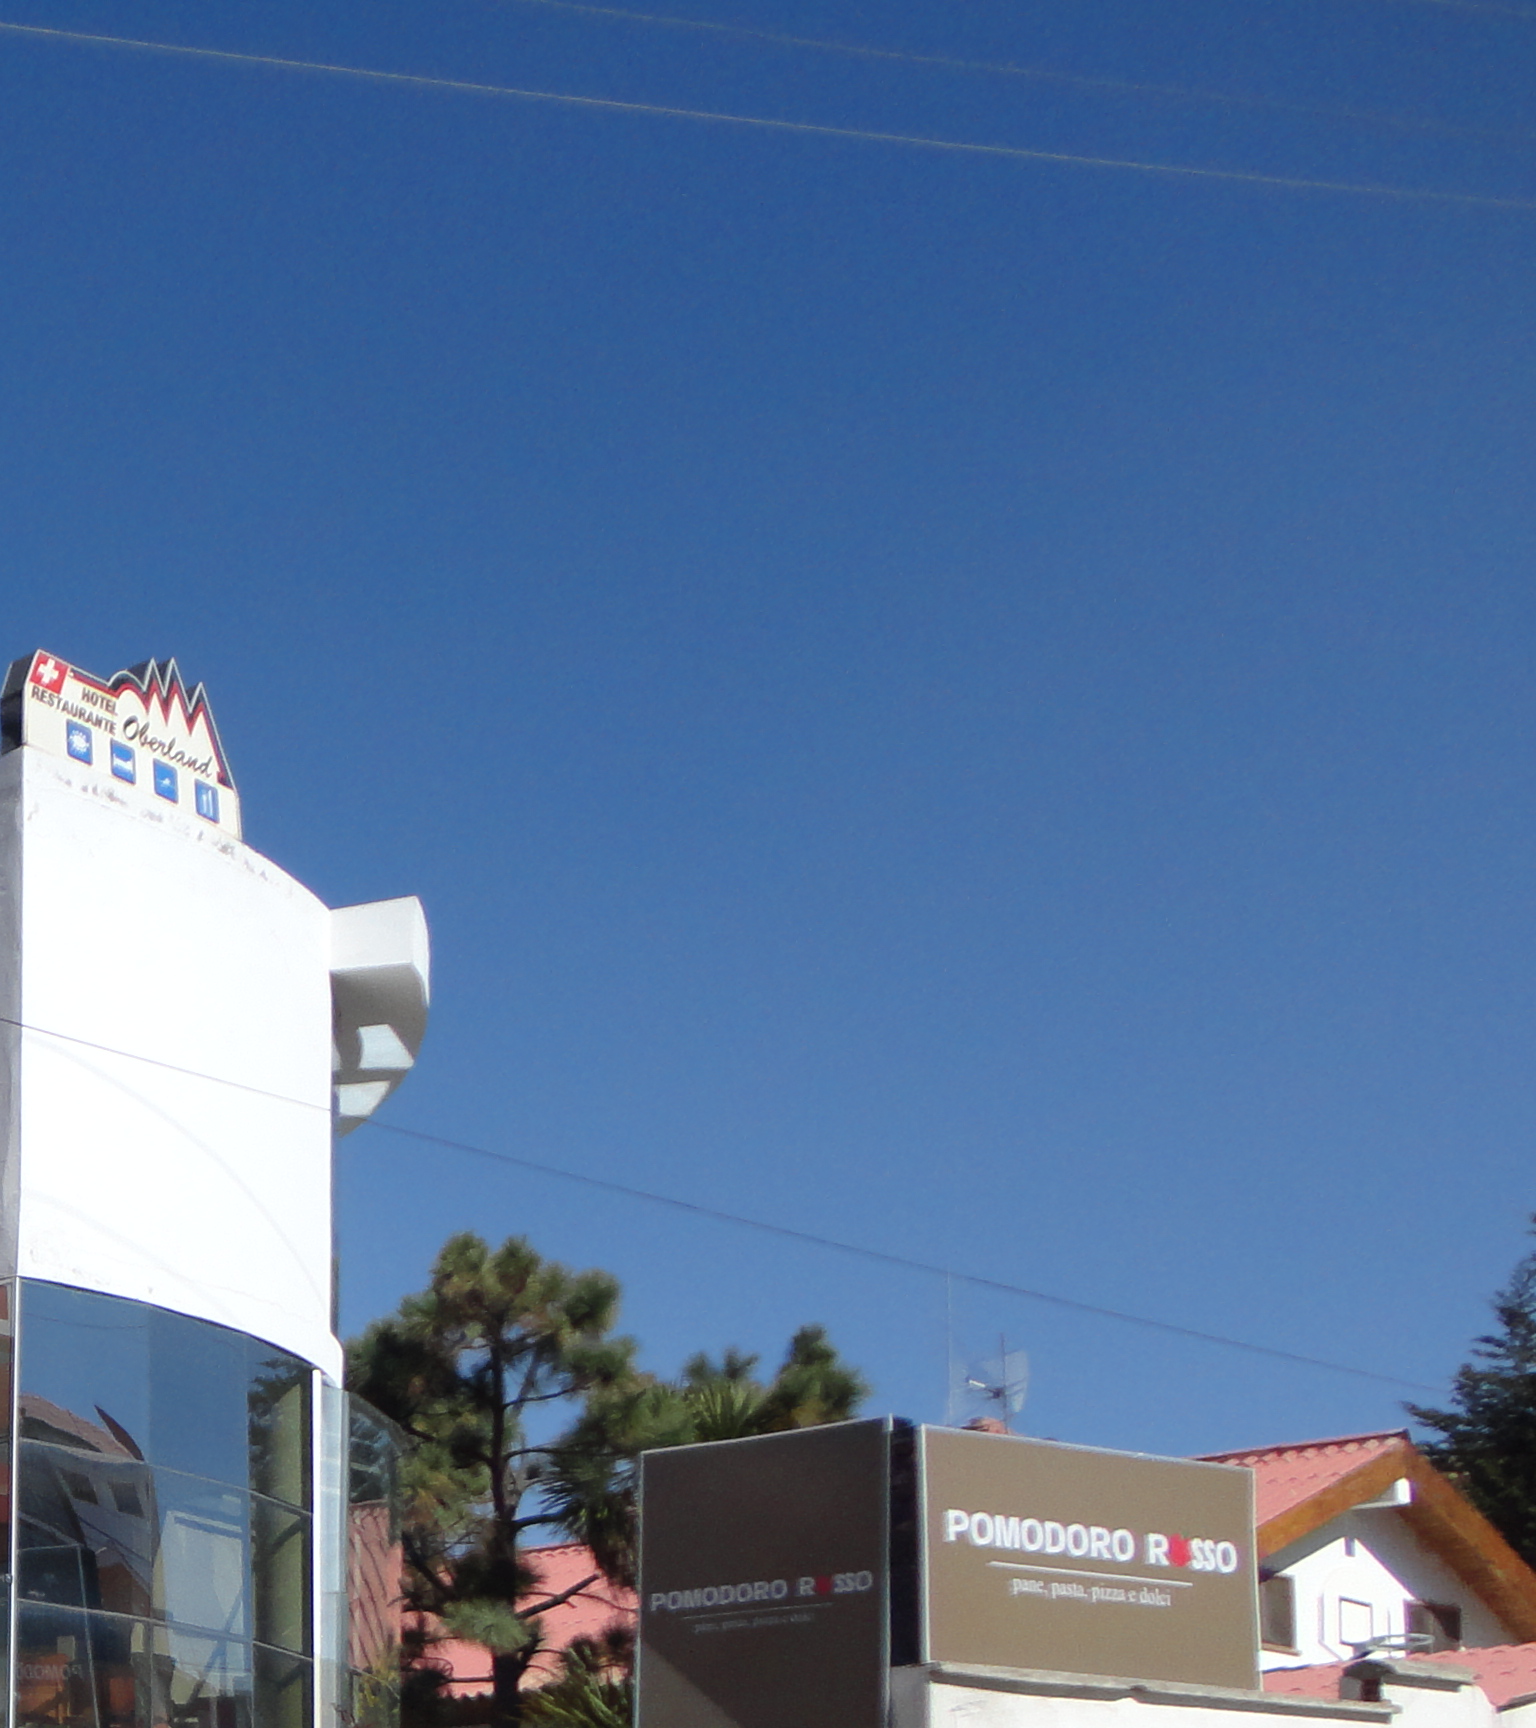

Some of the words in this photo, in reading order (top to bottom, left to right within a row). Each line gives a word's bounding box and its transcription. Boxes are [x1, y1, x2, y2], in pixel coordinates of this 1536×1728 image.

[31, 686, 116, 735] RESTAURANTE
[81, 689, 118, 716] HOTEL
[123, 716, 213, 778] Oberland
[943, 1508, 1136, 1563] POMODORO
[650, 1579, 788, 1612] POMODORO
